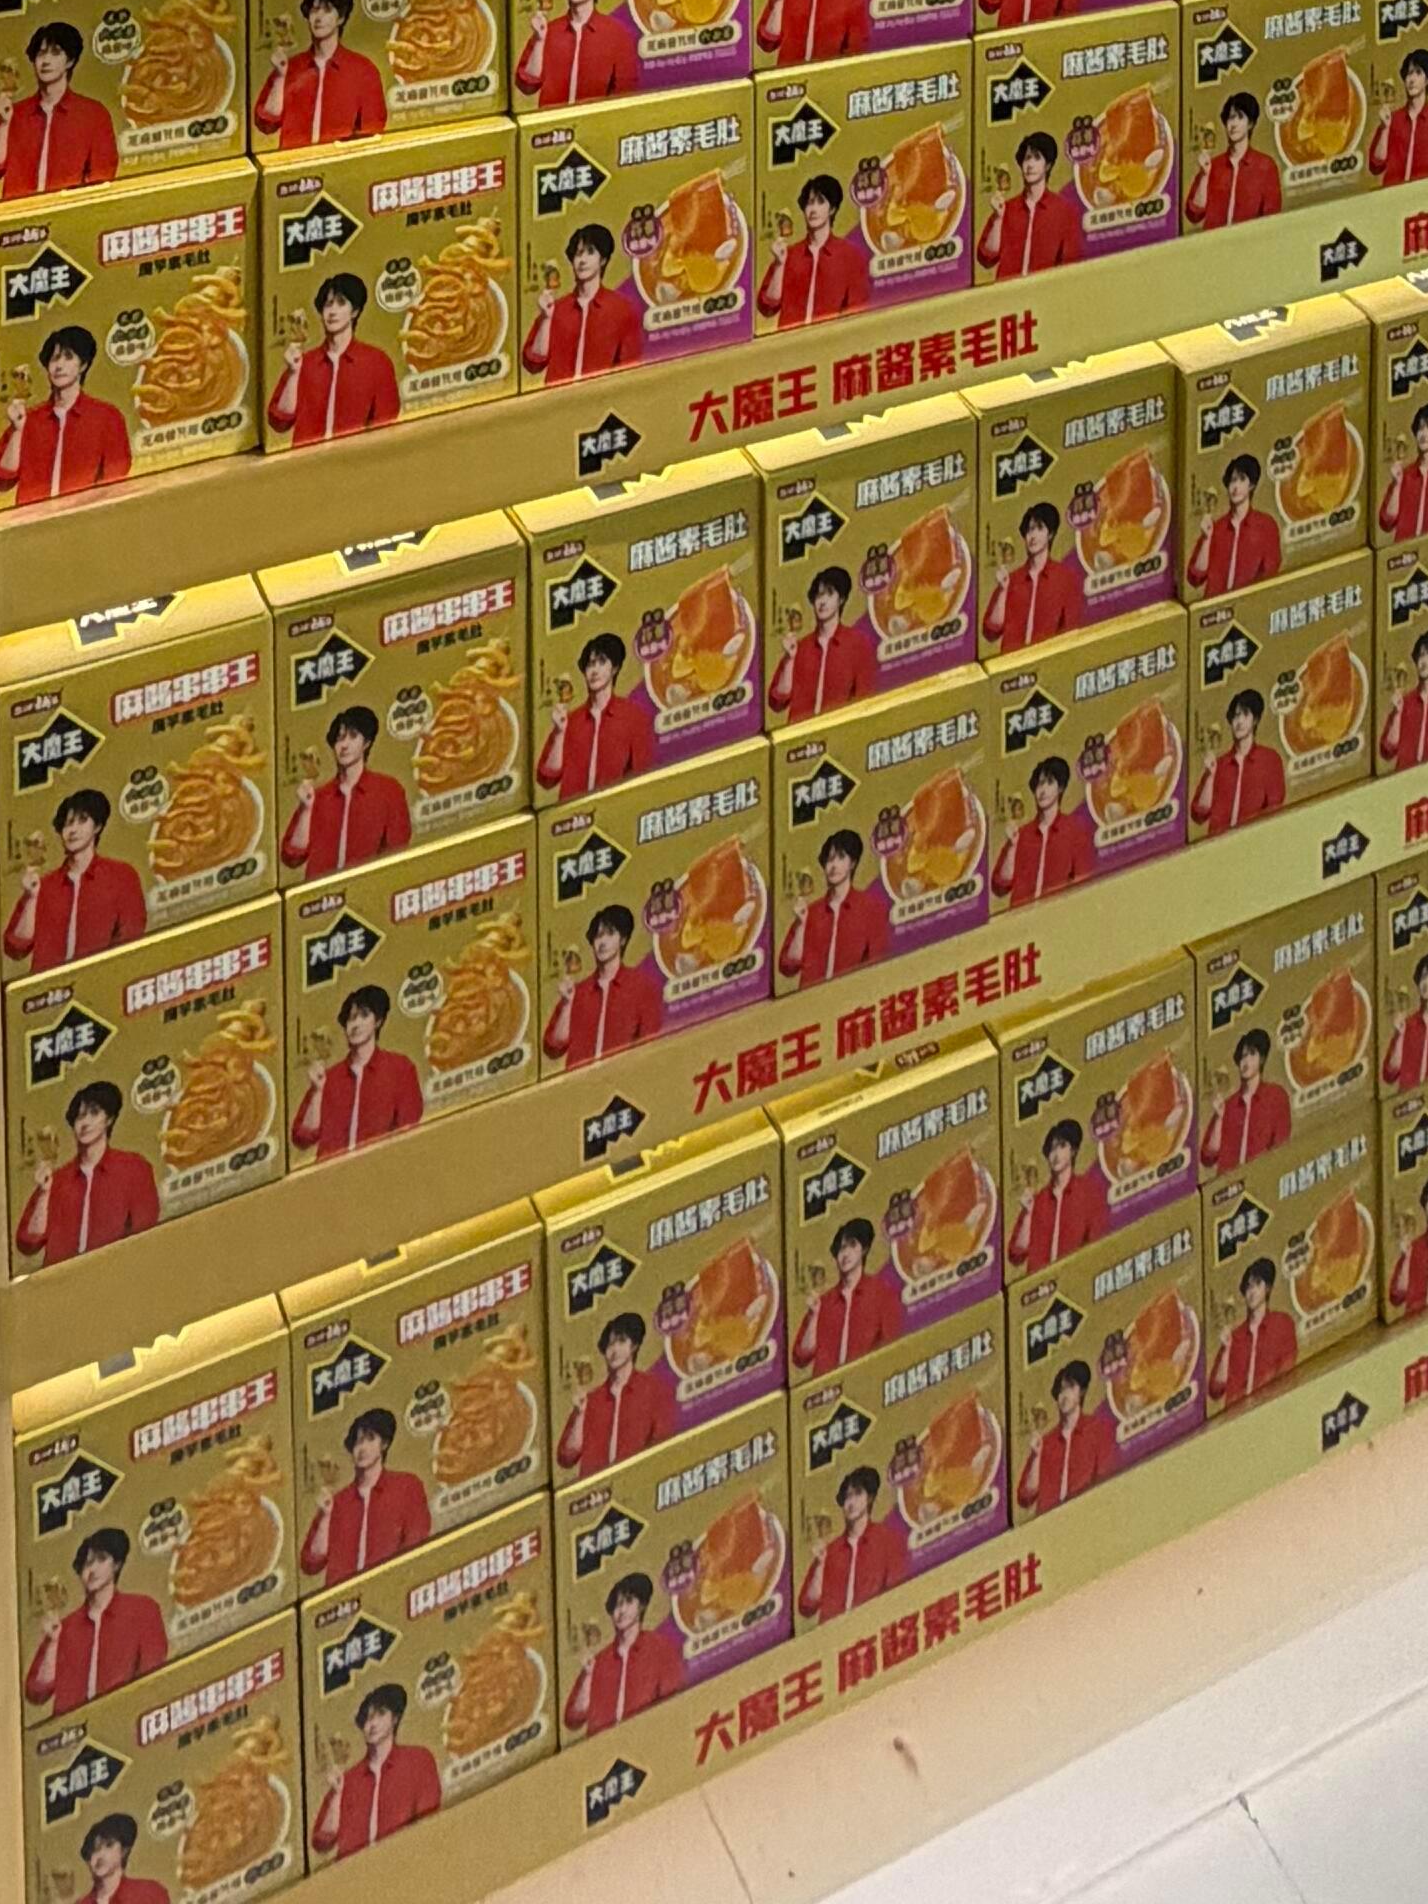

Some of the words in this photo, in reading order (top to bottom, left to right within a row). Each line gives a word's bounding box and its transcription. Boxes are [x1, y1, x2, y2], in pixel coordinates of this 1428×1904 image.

[580, 430, 628, 456] 大魔王
[689, 365, 818, 443] 大魔王
[832, 311, 1039, 404] 麻酱素毛肚
[585, 1110, 632, 1140] 大魔王
[693, 1024, 822, 1115] 大魔王
[836, 943, 1043, 1060] 麻酱素毛肚
[590, 1775, 635, 1807] 大魔王
[696, 1661, 824, 1766] 大魔王
[838, 1553, 1044, 1694] 麻酱素毛肚
